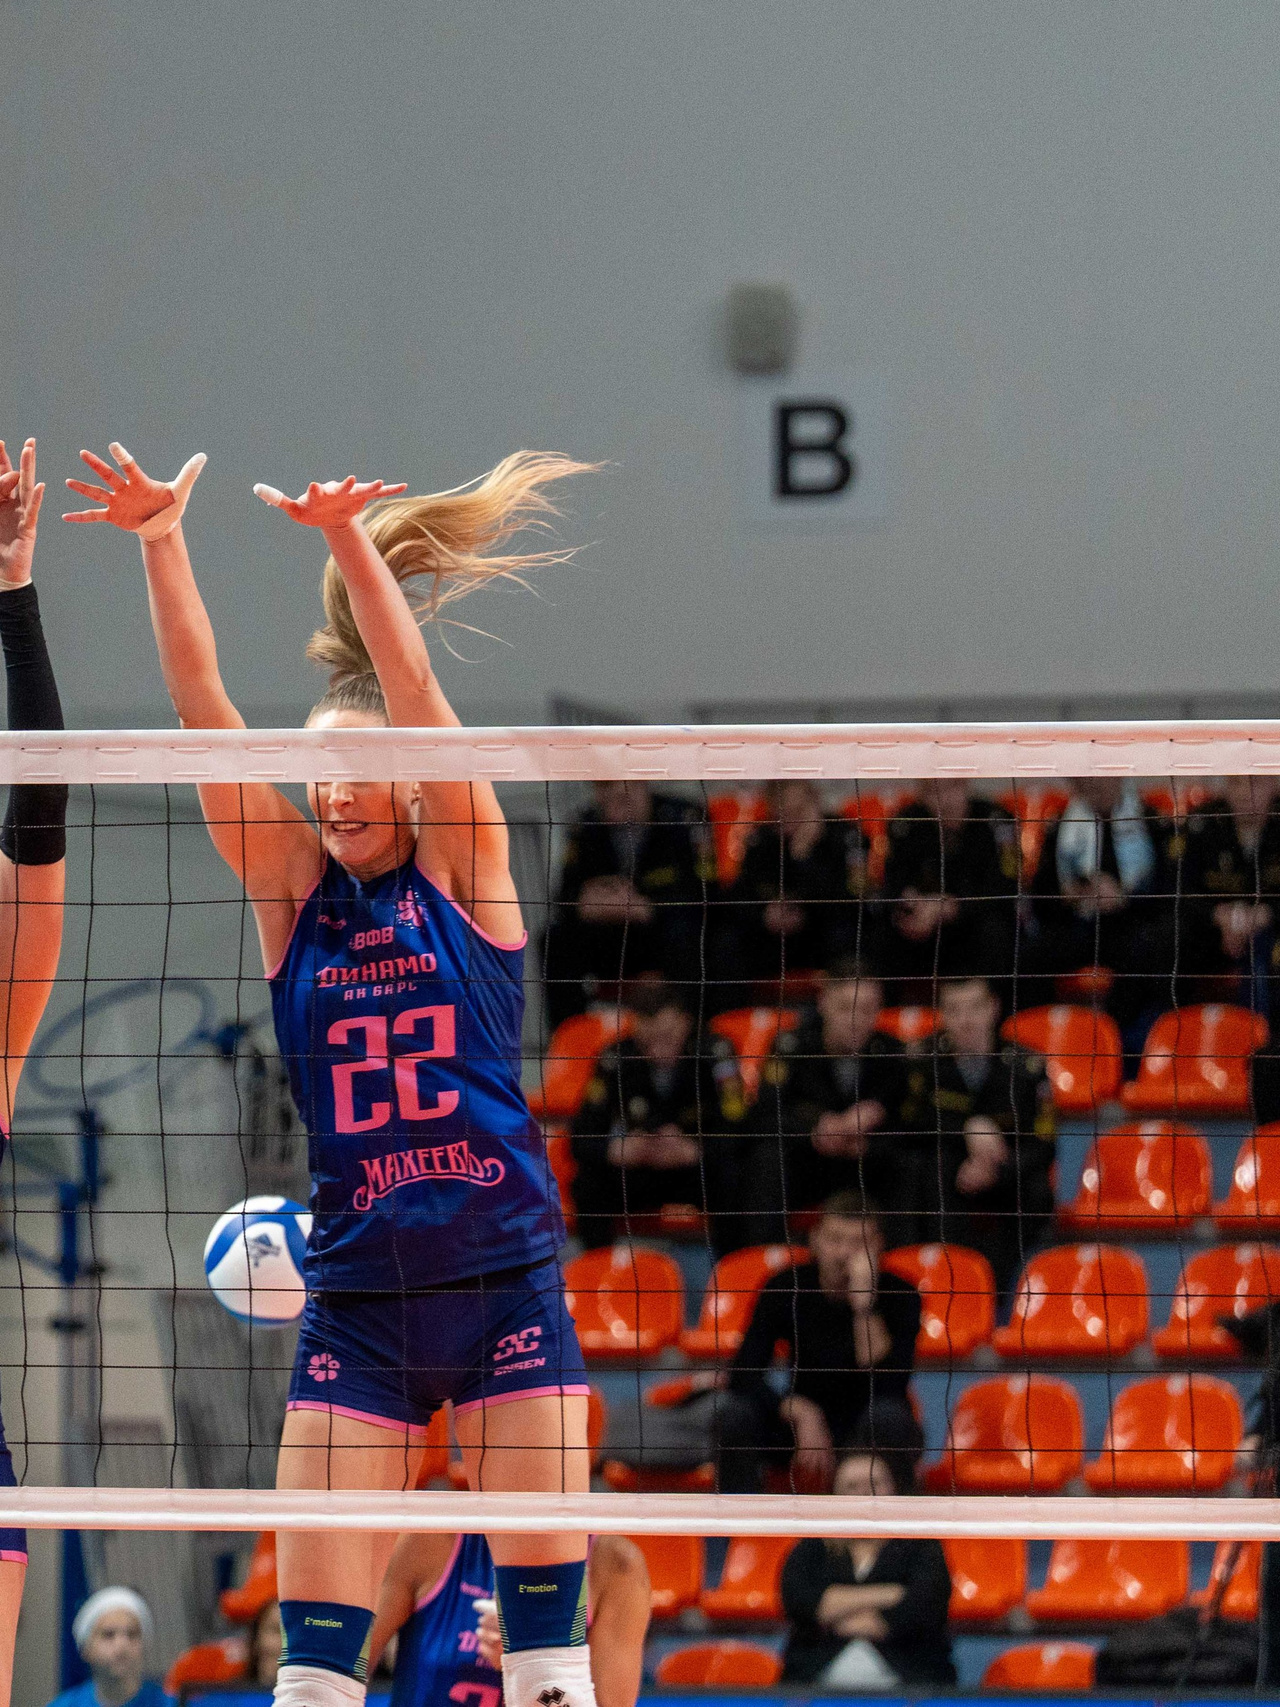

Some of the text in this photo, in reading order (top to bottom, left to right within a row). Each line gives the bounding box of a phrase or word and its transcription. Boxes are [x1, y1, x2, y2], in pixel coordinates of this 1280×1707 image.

[354, 926, 395, 951] ВФВ
[316, 952, 437, 988] ДИНАМО
[344, 988, 366, 1001] АК
[327, 1004, 460, 1134] 22
